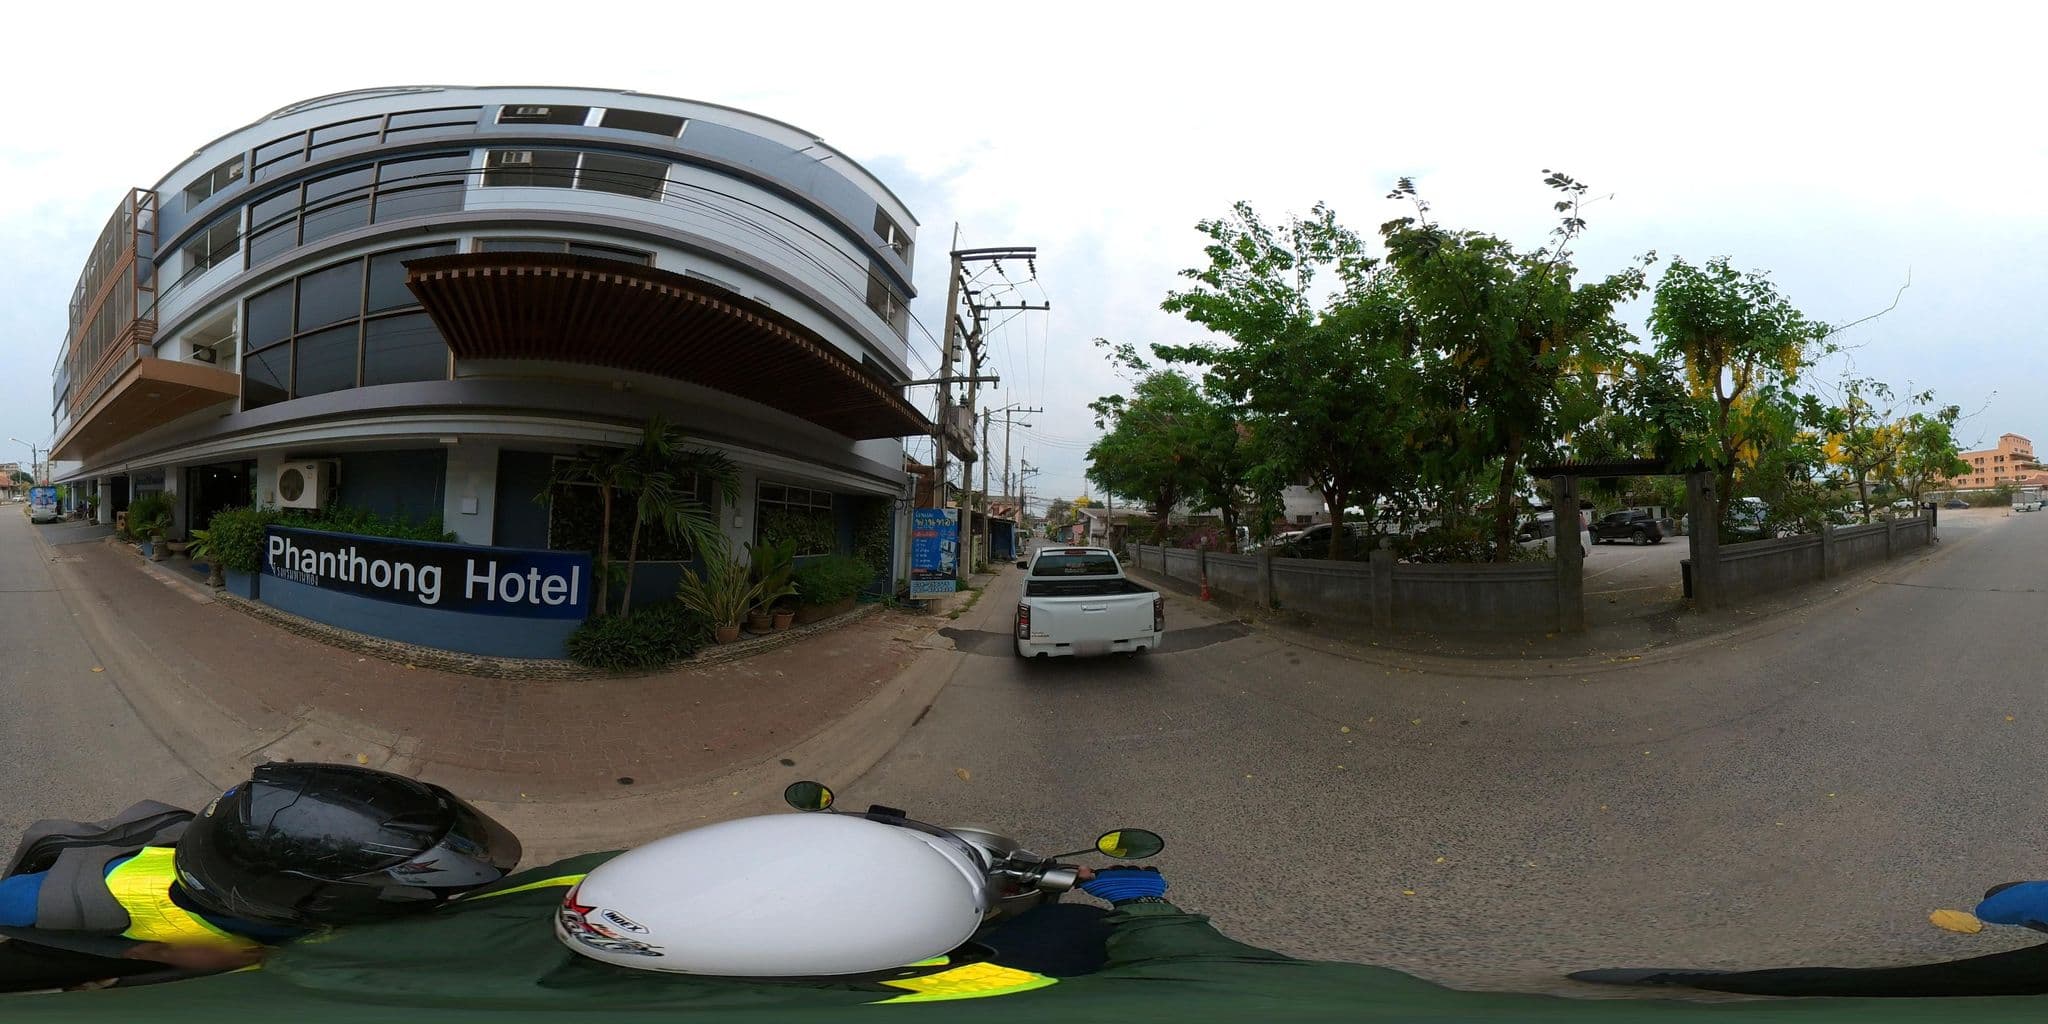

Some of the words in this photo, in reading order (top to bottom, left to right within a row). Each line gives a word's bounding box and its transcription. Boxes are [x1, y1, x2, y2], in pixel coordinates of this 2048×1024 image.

[269, 535, 442, 605] Phanthong
[466, 558, 580, 605] Hotel
[605, 912, 643, 932] INDEX
